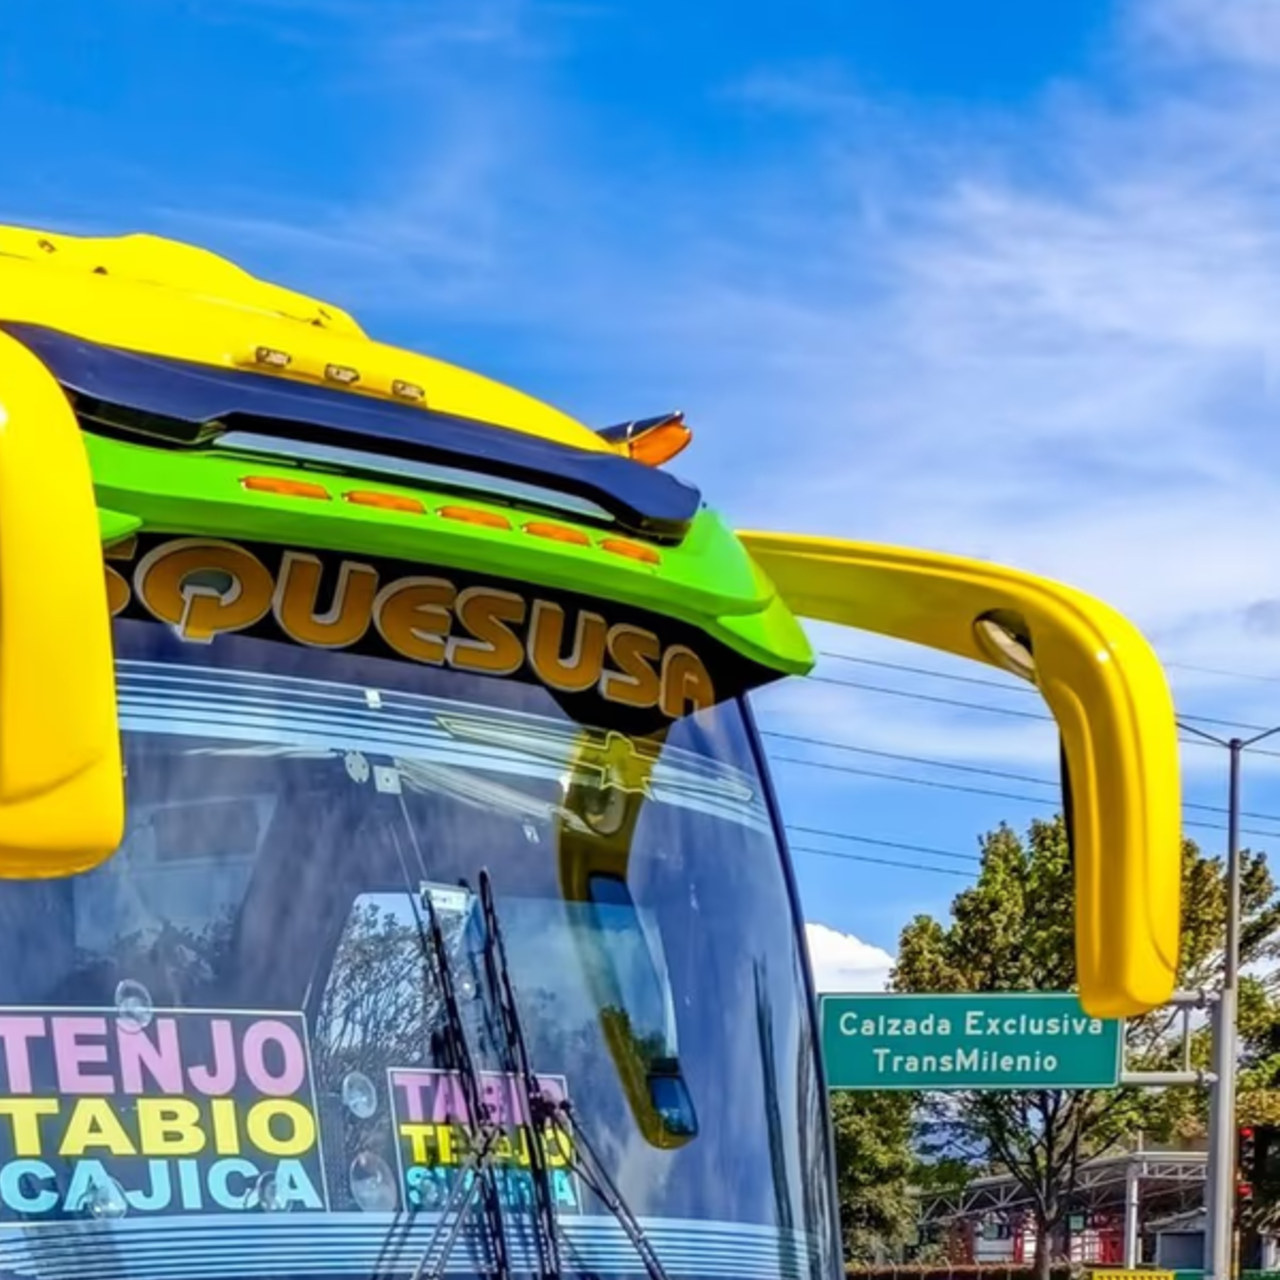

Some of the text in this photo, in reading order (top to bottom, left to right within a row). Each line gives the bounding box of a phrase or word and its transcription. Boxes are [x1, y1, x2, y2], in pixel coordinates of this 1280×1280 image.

[839, 1010, 1104, 1037] Calzada Exclusiva
[872, 1048, 1058, 1074] TransMilenio
